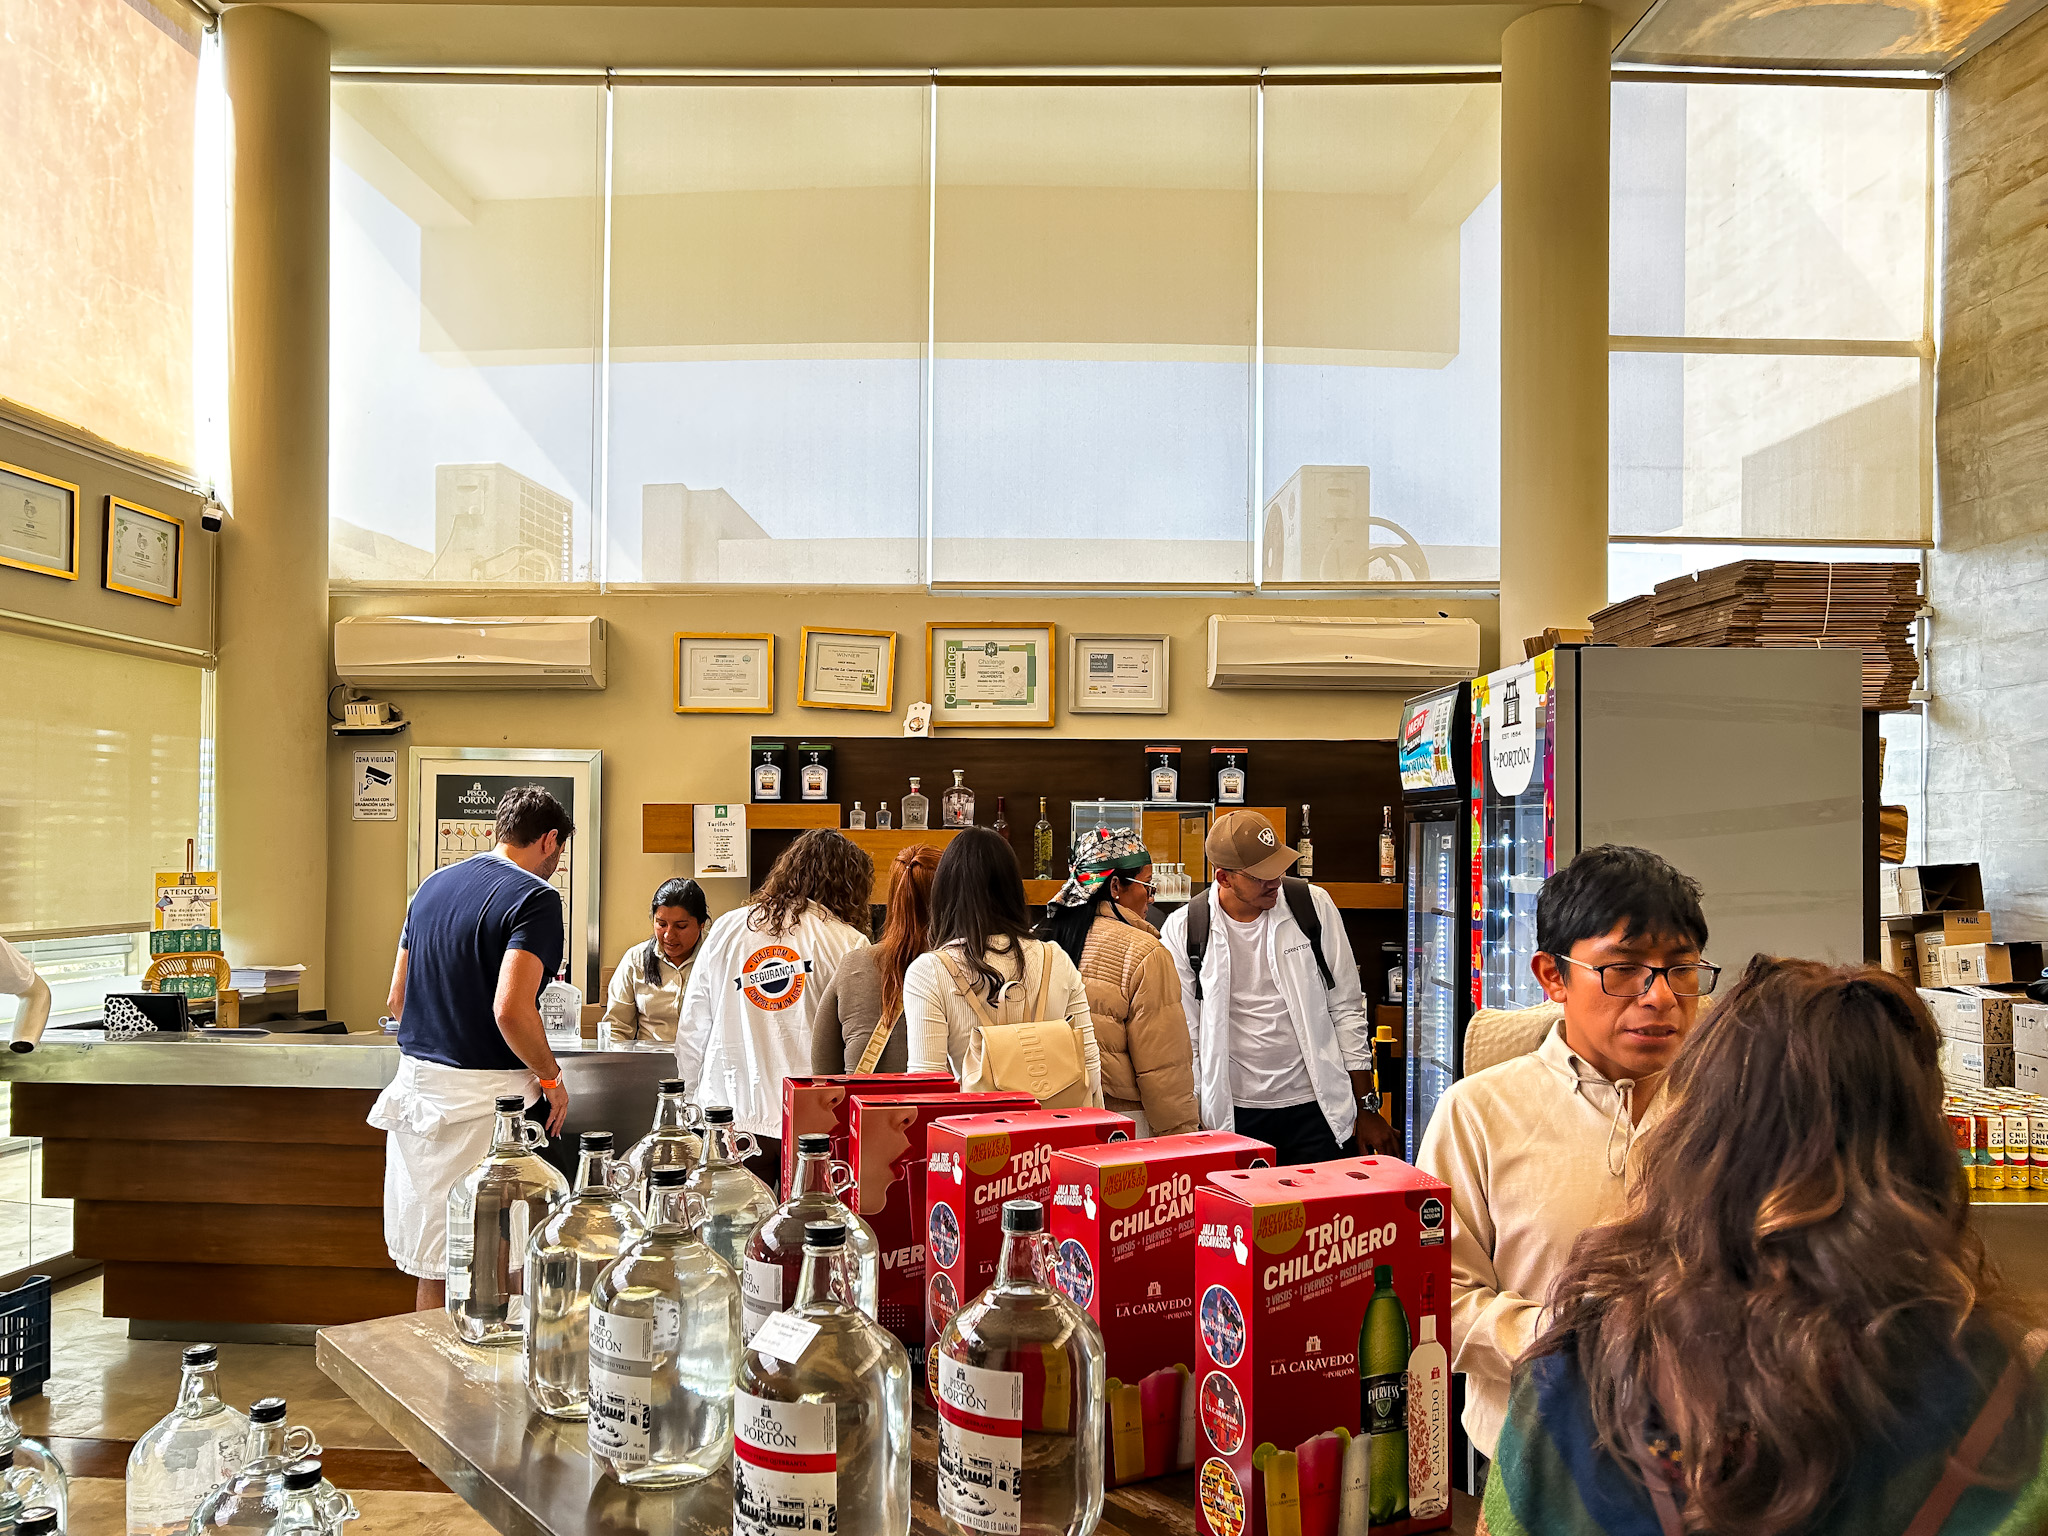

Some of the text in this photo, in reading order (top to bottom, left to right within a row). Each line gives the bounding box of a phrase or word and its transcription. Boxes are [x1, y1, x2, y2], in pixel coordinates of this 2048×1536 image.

[164, 887, 210, 895] ATENCIÓN
[752, 948, 788, 964] VIAJE COM
[750, 964, 795, 984] SEGURANÇA
[749, 989, 768, 1009] COMPRE
[783, 997, 793, 1007] UM
[793, 977, 803, 1000] AGENTE
[969, 1145, 1009, 1163] POSAVASOS
[971, 1137, 1006, 1154] INCLUYE 3
[1010, 1142, 1052, 1173] TRÍO
[974, 1164, 1051, 1205] CHILCAN
[1106, 1167, 1143, 1185] INCLUYE 3
[1056, 1184, 1080, 1195] JALA TUS
[1103, 1176, 1146, 1197] POSAVASOS
[1147, 1172, 1191, 1206] TRÍO
[1053, 1193, 1082, 1206] POSAVASOS
[1110, 1193, 1194, 1242] CHILCAN
[1259, 1206, 1300, 1225] INCLUYE 3
[1200, 1224, 1228, 1236] JALA TUS
[1256, 1216, 1304, 1240] POSAVASOS
[1305, 1213, 1355, 1251] TRÍO
[1112, 1246, 1116, 1257] 3
[1117, 1240, 1136, 1255] VASOS
[1198, 1235, 1231, 1249] POSAVASOS
[1264, 1222, 1397, 1290] CHILCANERO
[980, 1264, 993, 1273] LA
[1266, 1297, 1270, 1307] 3
[1271, 1289, 1293, 1306] VASOS
[1304, 1274, 1334, 1294] EVERVESS
[1340, 1264, 1357, 1280] PISCO
[1358, 1258, 1374, 1273] PURO
[1116, 1297, 1192, 1318] LA CARAVEDO
[593, 1324, 613, 1342] PISCO
[616, 1363, 631, 1371] VERDE
[1271, 1353, 1354, 1376] LA CARAVEDO
[950, 1377, 975, 1395] PISCO
[1368, 1385, 1400, 1404] EVERVESS
[752, 1416, 782, 1433] PISCO
[1431, 1389, 1440, 1501] LA CARAVEDO
[770, 1457, 807, 1467] QUEBRANTA
[973, 1516, 990, 1529] EXCESO
[991, 1521, 997, 1530] ES
[997, 1522, 1017, 1533] DAÑINO
